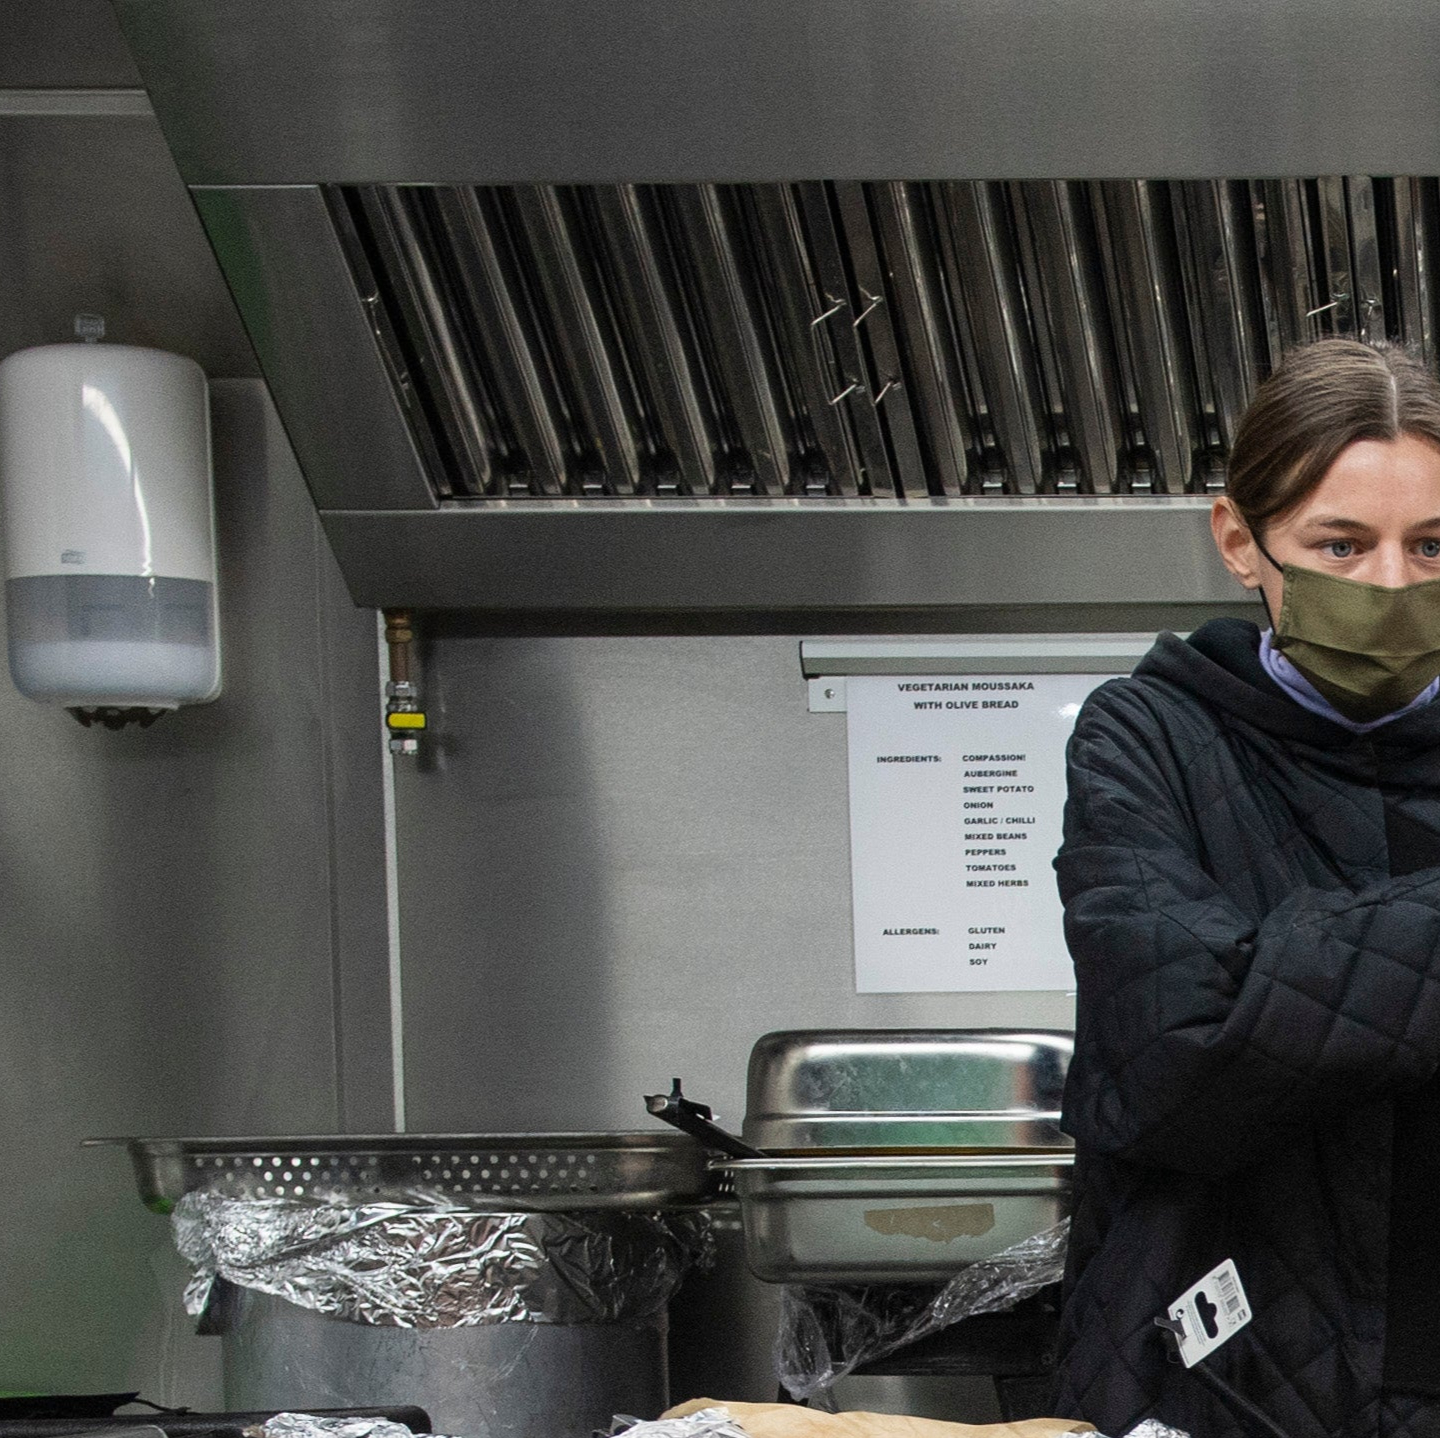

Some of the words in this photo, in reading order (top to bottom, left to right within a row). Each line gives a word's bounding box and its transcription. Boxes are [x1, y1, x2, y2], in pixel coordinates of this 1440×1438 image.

[897, 682, 969, 693] VEGETARIAN
[971, 681, 1035, 692] MOUSSAKA
[913, 700, 943, 711] WITH
[945, 700, 979, 710] OLIVE
[981, 700, 1020, 710] BREAD
[876, 754, 943, 764] INGREDIENTS:
[961, 753, 1027, 763] COMPASSION!
[963, 769, 1019, 778] AUBERGINE
[962, 784, 995, 794] SWEET
[996, 785, 1035, 793] POTATO
[962, 801, 994, 810] ONION
[963, 816, 999, 826] GARLIC
[1005, 816, 1036, 825] CHILLI
[964, 832, 995, 841] MIXED
[996, 832, 1028, 841] BEANS
[964, 848, 1007, 857] PEPPERS
[966, 863, 1017, 872] TOMATOES
[965, 879, 996, 888] MIXED
[997, 879, 1030, 888] HERBS
[882, 927, 940, 936] ALLERGENS:
[967, 926, 1006, 935] GLUTEN
[968, 942, 998, 951] DAIRY
[969, 958, 989, 966] SOY
